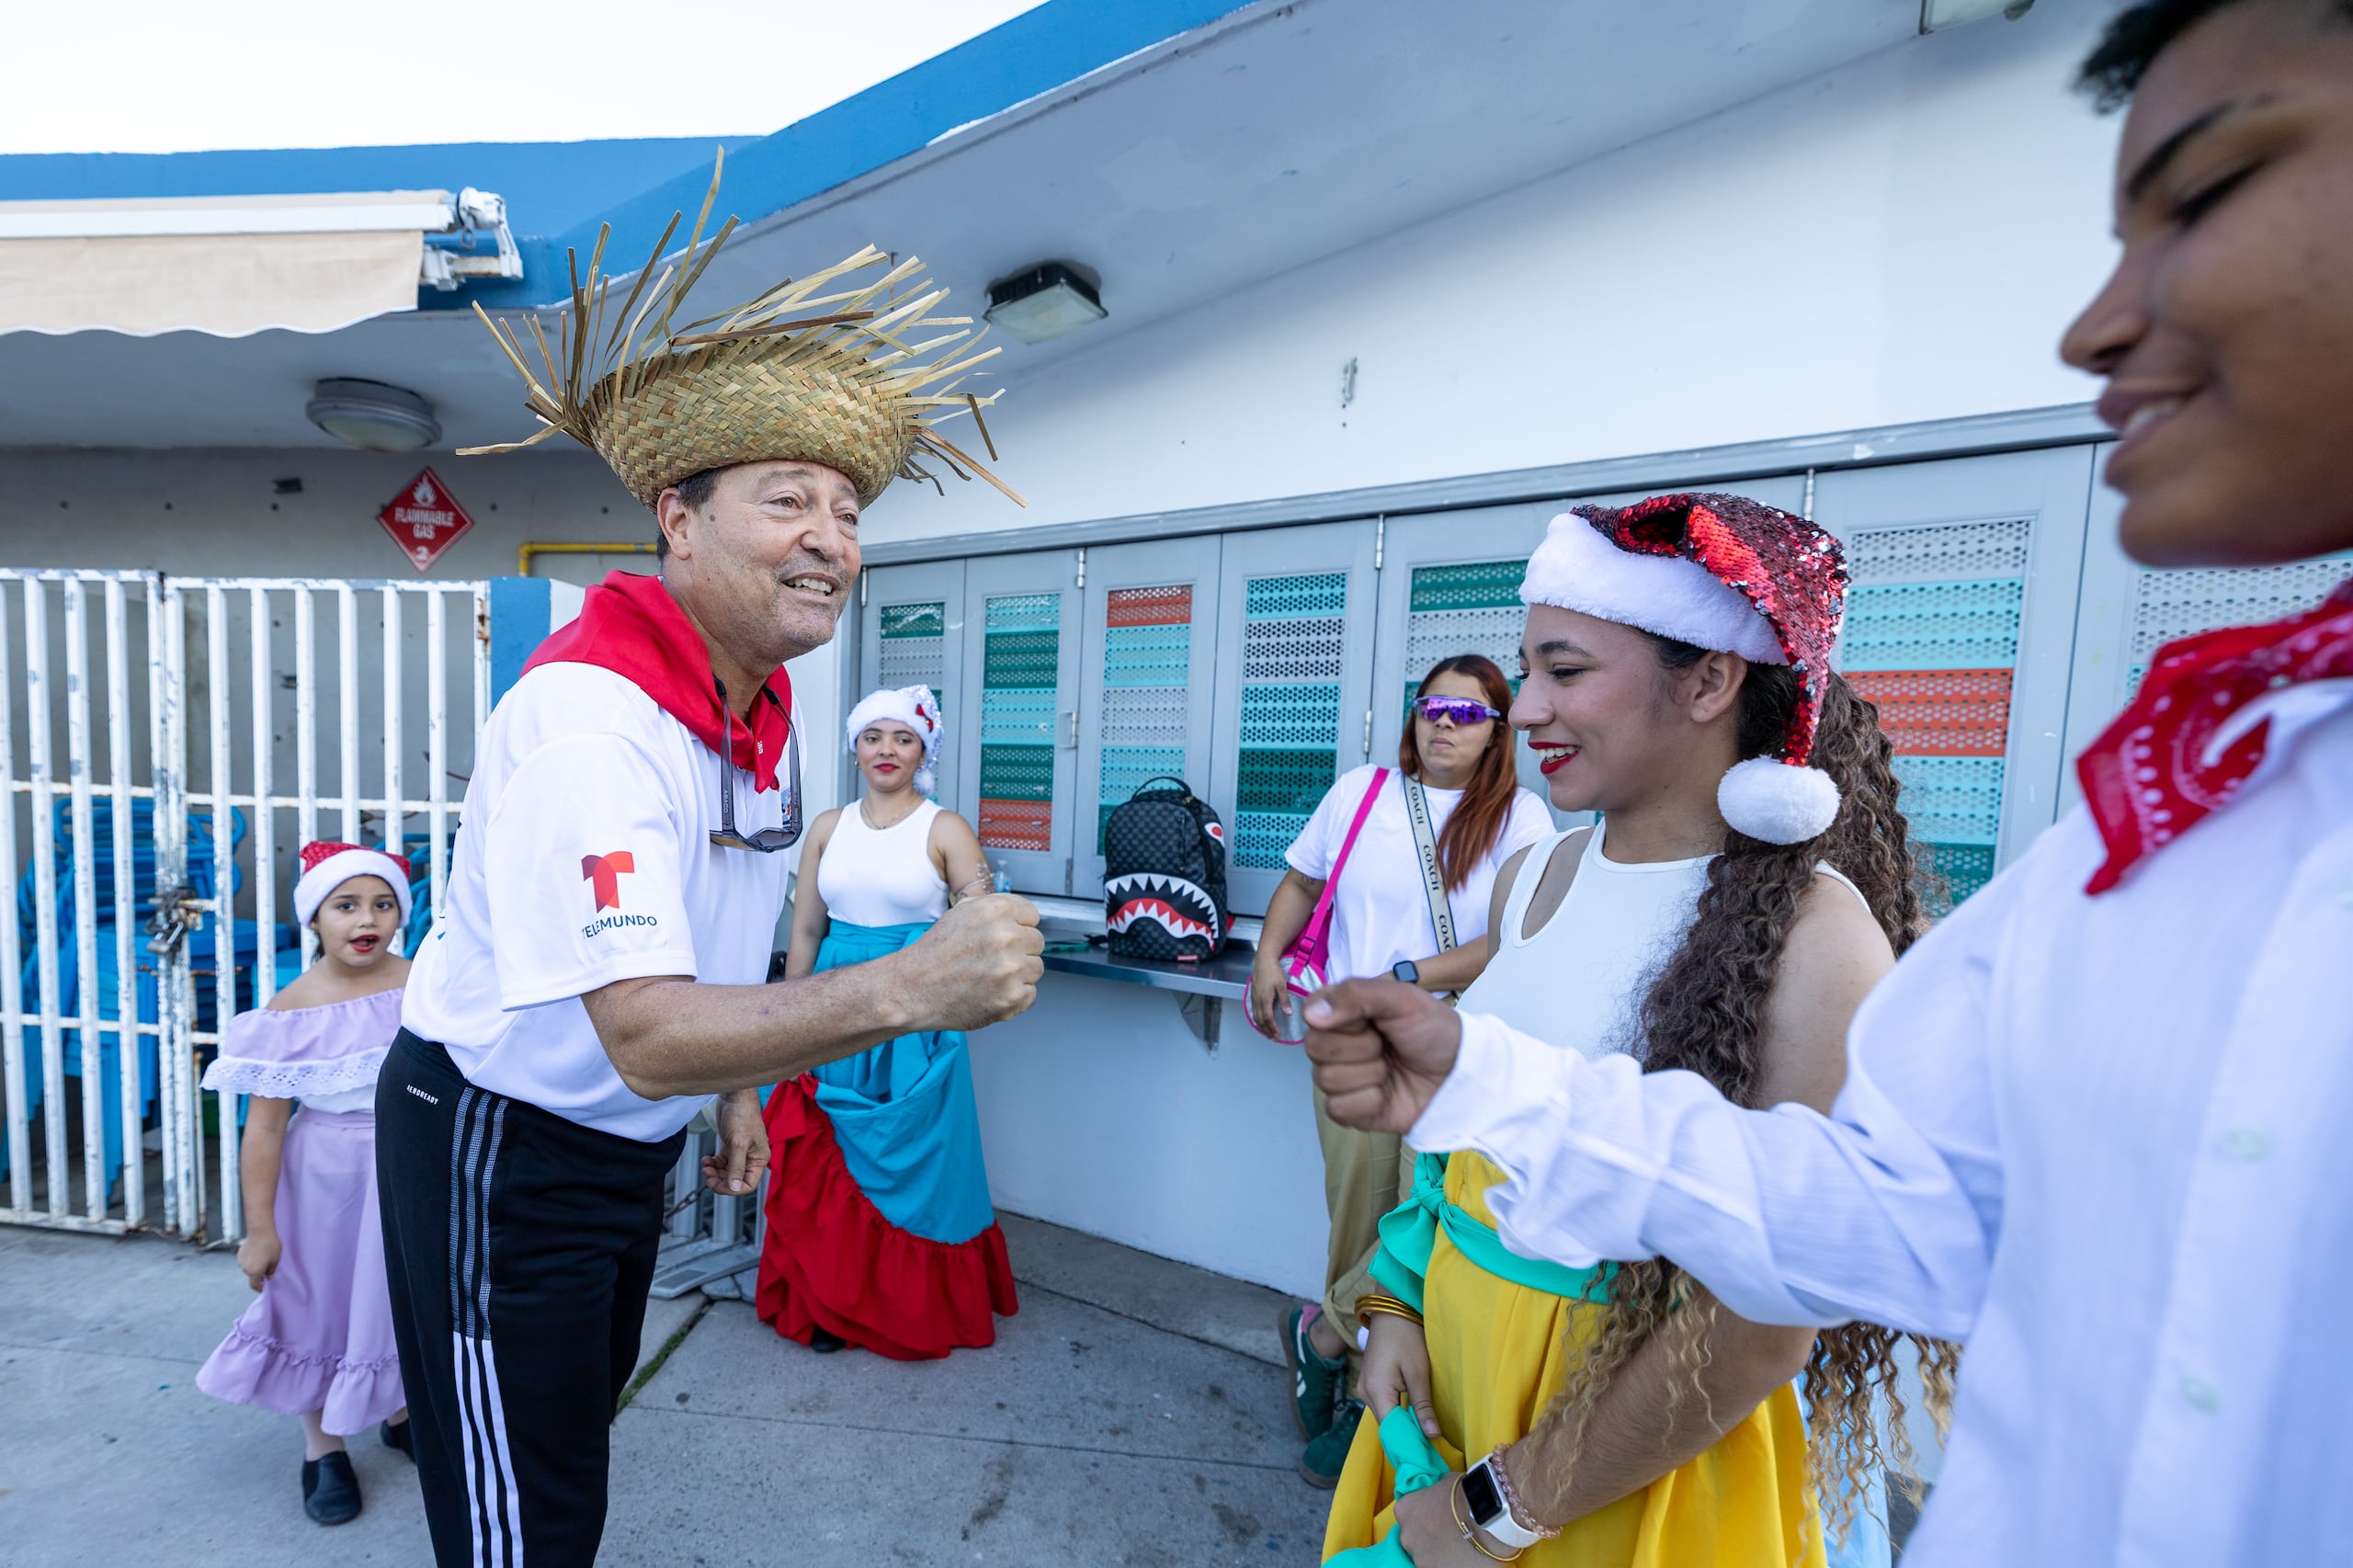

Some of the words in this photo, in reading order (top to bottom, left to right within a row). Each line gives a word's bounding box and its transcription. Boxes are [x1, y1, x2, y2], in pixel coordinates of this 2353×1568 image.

[394, 507, 454, 527] FLAMMABLE
[413, 523, 435, 540] GAS
[415, 546, 428, 561] 2
[1411, 786, 1425, 824] COACH
[1423, 845, 1439, 891] COACH
[1438, 914, 1452, 951] COAC
[406, 1084, 439, 1105] AEROREADY
